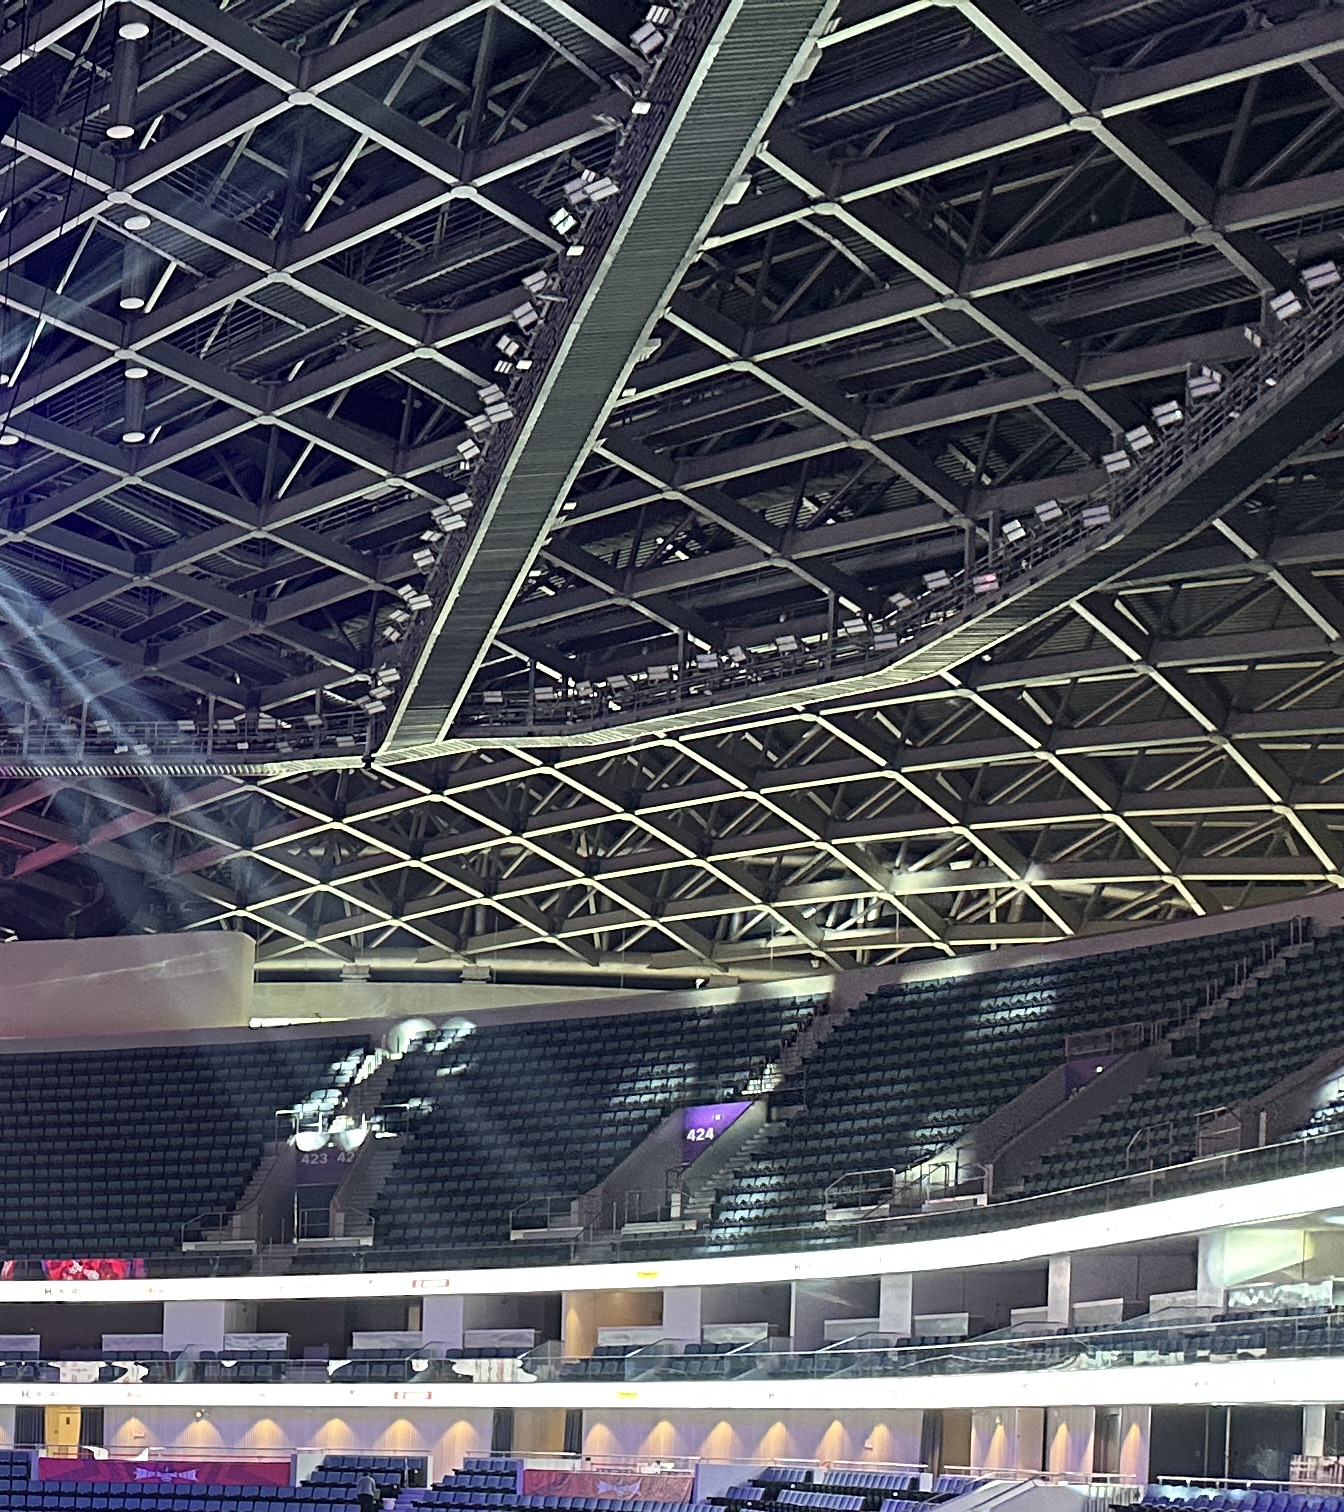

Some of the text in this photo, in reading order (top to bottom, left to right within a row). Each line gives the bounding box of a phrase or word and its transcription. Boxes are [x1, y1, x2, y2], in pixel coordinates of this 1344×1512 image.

[686, 1127, 715, 1143] 424
[301, 1151, 356, 1166] 423 42
